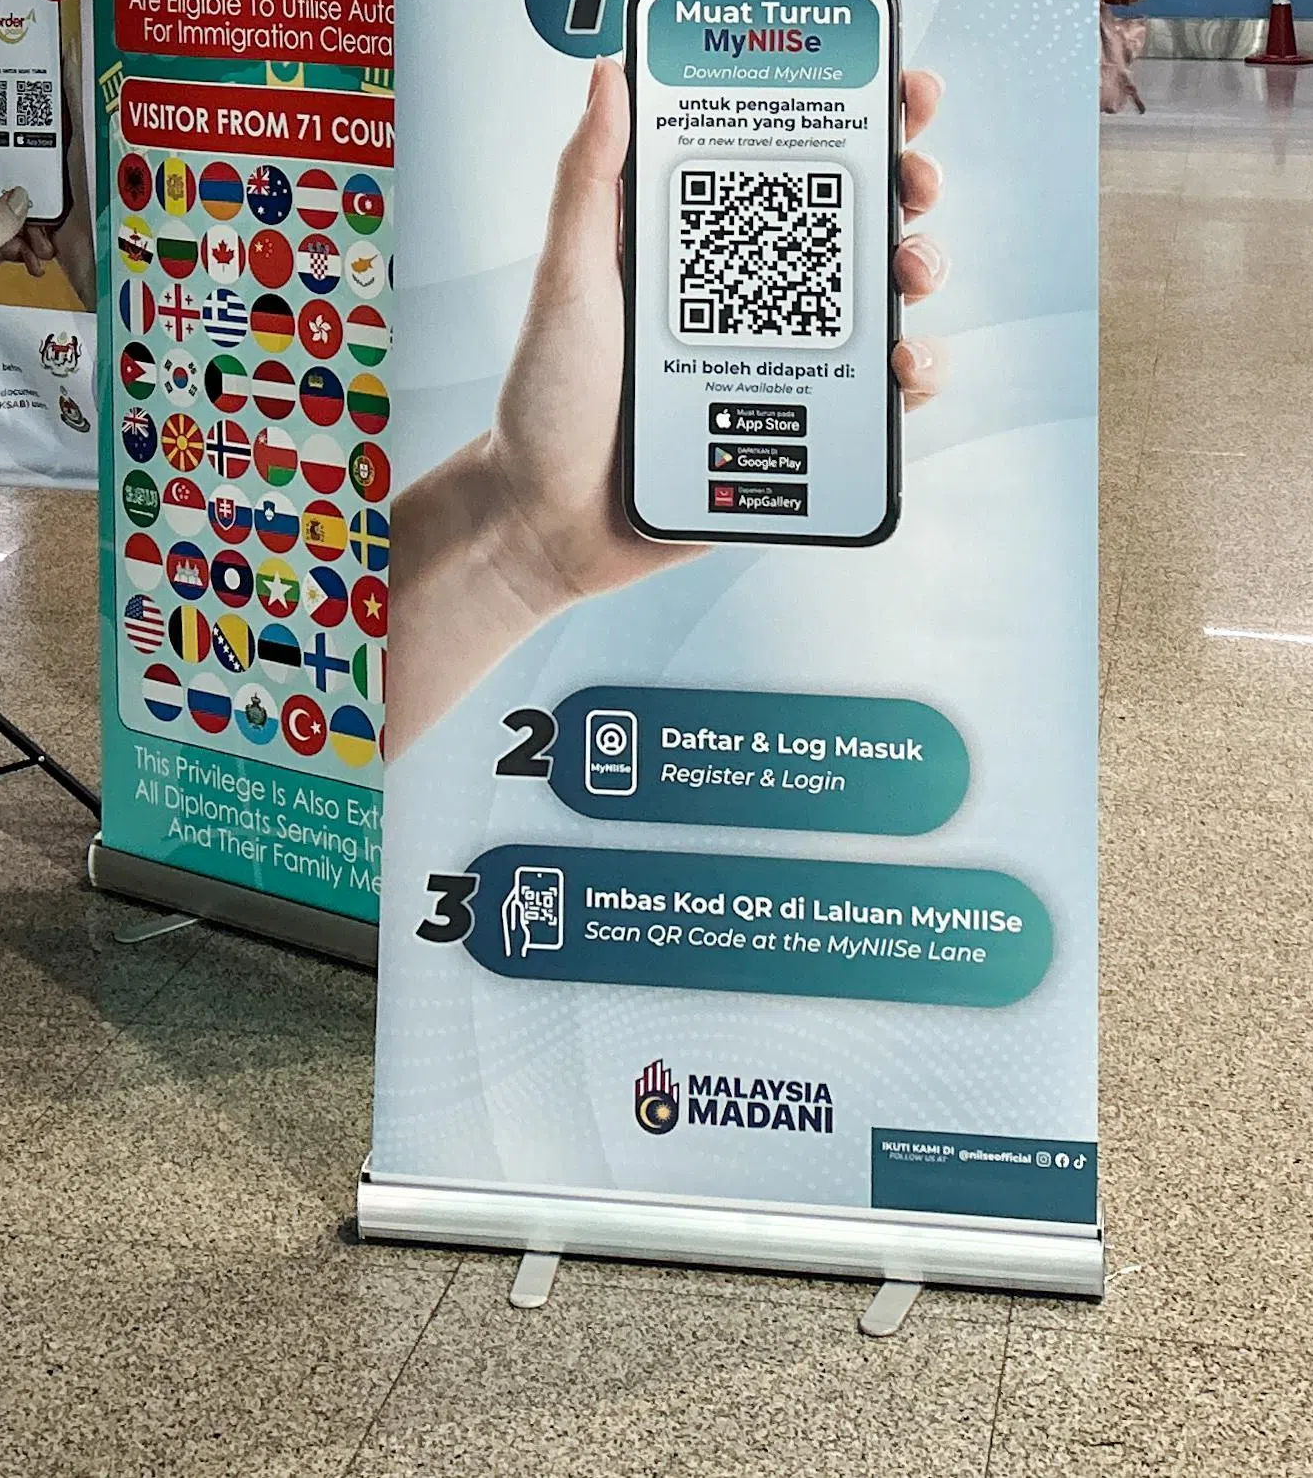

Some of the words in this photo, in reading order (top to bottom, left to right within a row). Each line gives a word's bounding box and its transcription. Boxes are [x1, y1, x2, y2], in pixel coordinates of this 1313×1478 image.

[675, 1, 753, 24] Muat
[760, 1, 852, 25] Turun
[144, 17, 173, 43] For
[178, 20, 313, 53] Immigration
[320, 25, 393, 56] Cleara
[703, 28, 822, 58] MyNIISe
[683, 65, 770, 81] Download
[774, 65, 843, 82] MyNIISe
[128, 101, 210, 134] VISITOR
[217, 109, 289, 139] FROM
[297, 114, 321, 141] 71
[679, 97, 730, 112] untuk
[736, 97, 846, 116] pengalaman
[656, 114, 749, 132] perjalanan
[752, 117, 795, 132] yang
[800, 116, 869, 130] baharu!
[678, 135, 693, 147] for
[710, 138, 733, 147] new
[738, 136, 773, 147] travel
[775, 137, 847, 150] experience!
[664, 359, 697, 374] Kini
[702, 360, 751, 375] boleh
[756, 362, 829, 380] didapati
[835, 364, 855, 378] di:
[705, 382, 734, 392] Now
[736, 382, 793, 394] Available
[796, 384, 813, 395] at:
[736, 417, 763, 432] App
[766, 418, 800, 431] Store
[737, 455, 777, 470] Google
[779, 456, 801, 471] Play
[738, 495, 802, 511] AppGallery
[496, 710, 555, 778] 2
[661, 727, 744, 752] Daftar
[752, 732, 770, 753] &
[778, 735, 826, 760] Log
[835, 736, 923, 762] Masuk
[134, 745, 170, 776] This
[176, 756, 266, 803] Privilege
[272, 780, 286, 807] Is
[293, 787, 340, 820] Also
[135, 778, 158, 806] All
[165, 785, 271, 835] Diplomats
[276, 814, 358, 864] Serving
[168, 817, 212, 848] And
[217, 829, 267, 864] Their
[273, 843, 343, 889] Family
[416, 874, 476, 942] 3
[585, 888, 667, 912] Imbas
[674, 892, 725, 914] Kod
[732, 895, 773, 919] QR
[780, 896, 805, 919] di
[813, 899, 902, 925] Laluan
[911, 904, 1022, 934] MyNIISe
[689, 1075, 833, 1104] MALAYSIA
[689, 1098, 834, 1133] MADANI
[913, 1143, 940, 1154] KAMI
[943, 1146, 954, 1155] DI
